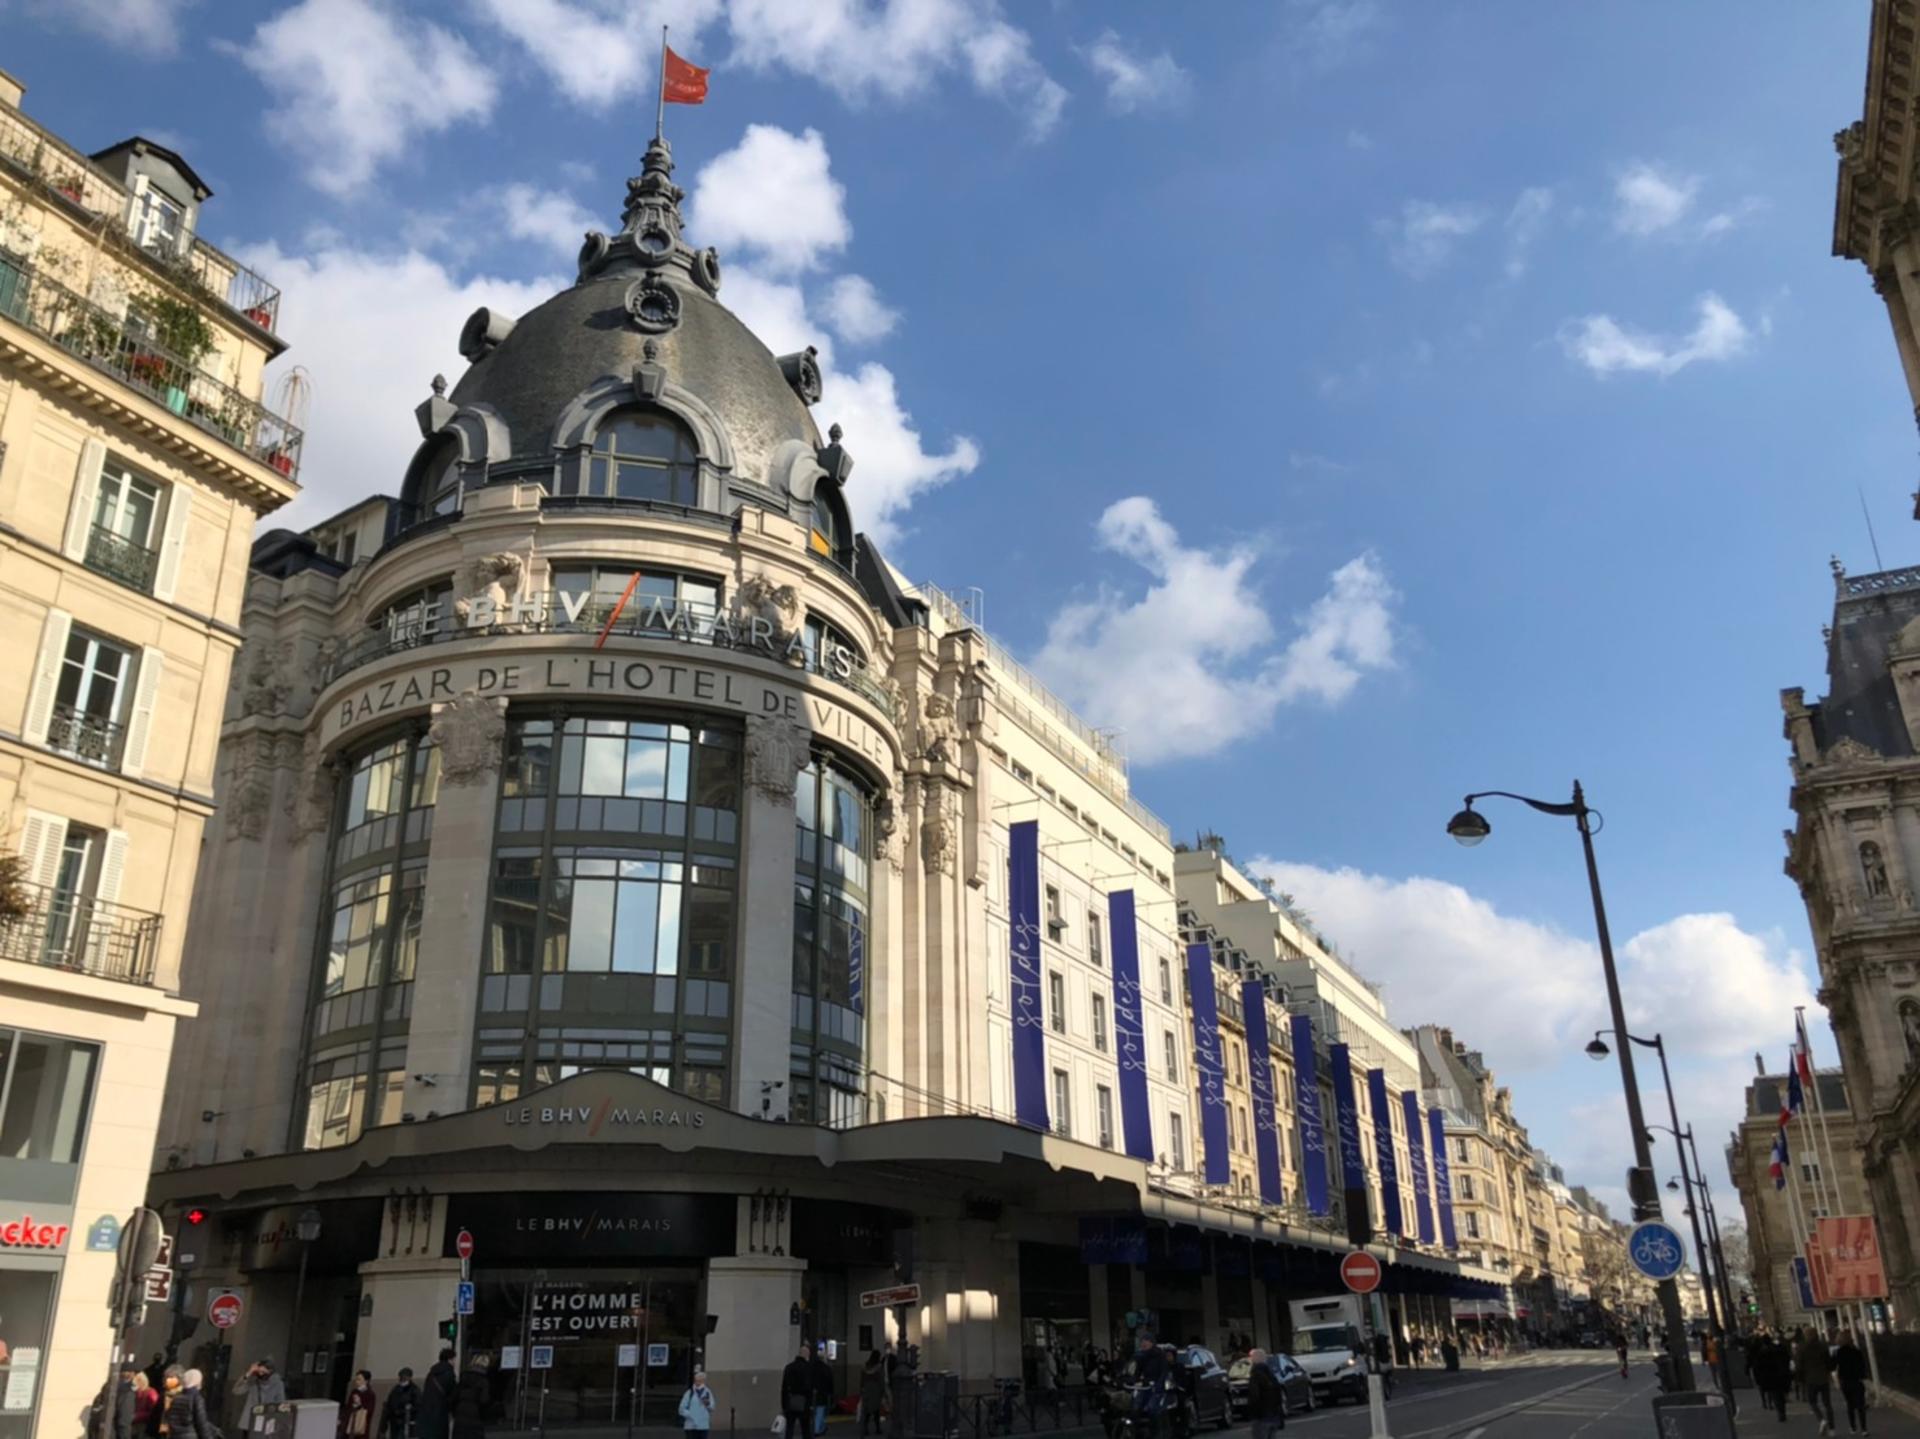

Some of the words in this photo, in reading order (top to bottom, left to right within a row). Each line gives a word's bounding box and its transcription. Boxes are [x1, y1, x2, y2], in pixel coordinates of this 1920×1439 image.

[389, 601, 442, 644] LE
[645, 596, 851, 677] MARAIS
[339, 668, 454, 728] BAZAR
[478, 666, 520, 691] DE
[547, 659, 742, 705] L'HOTEL
[763, 690, 797, 718] DE
[813, 700, 882, 764] VILLE
[505, 1108, 530, 1124] LE
[611, 1108, 704, 1127] MARAIS
[0, 1216, 68, 1245] cker
[517, 1218, 537, 1231] LE
[597, 1218, 671, 1231] MARAIS
[532, 1317, 562, 1330] EST
[569, 1315, 640, 1330] OUVERT
